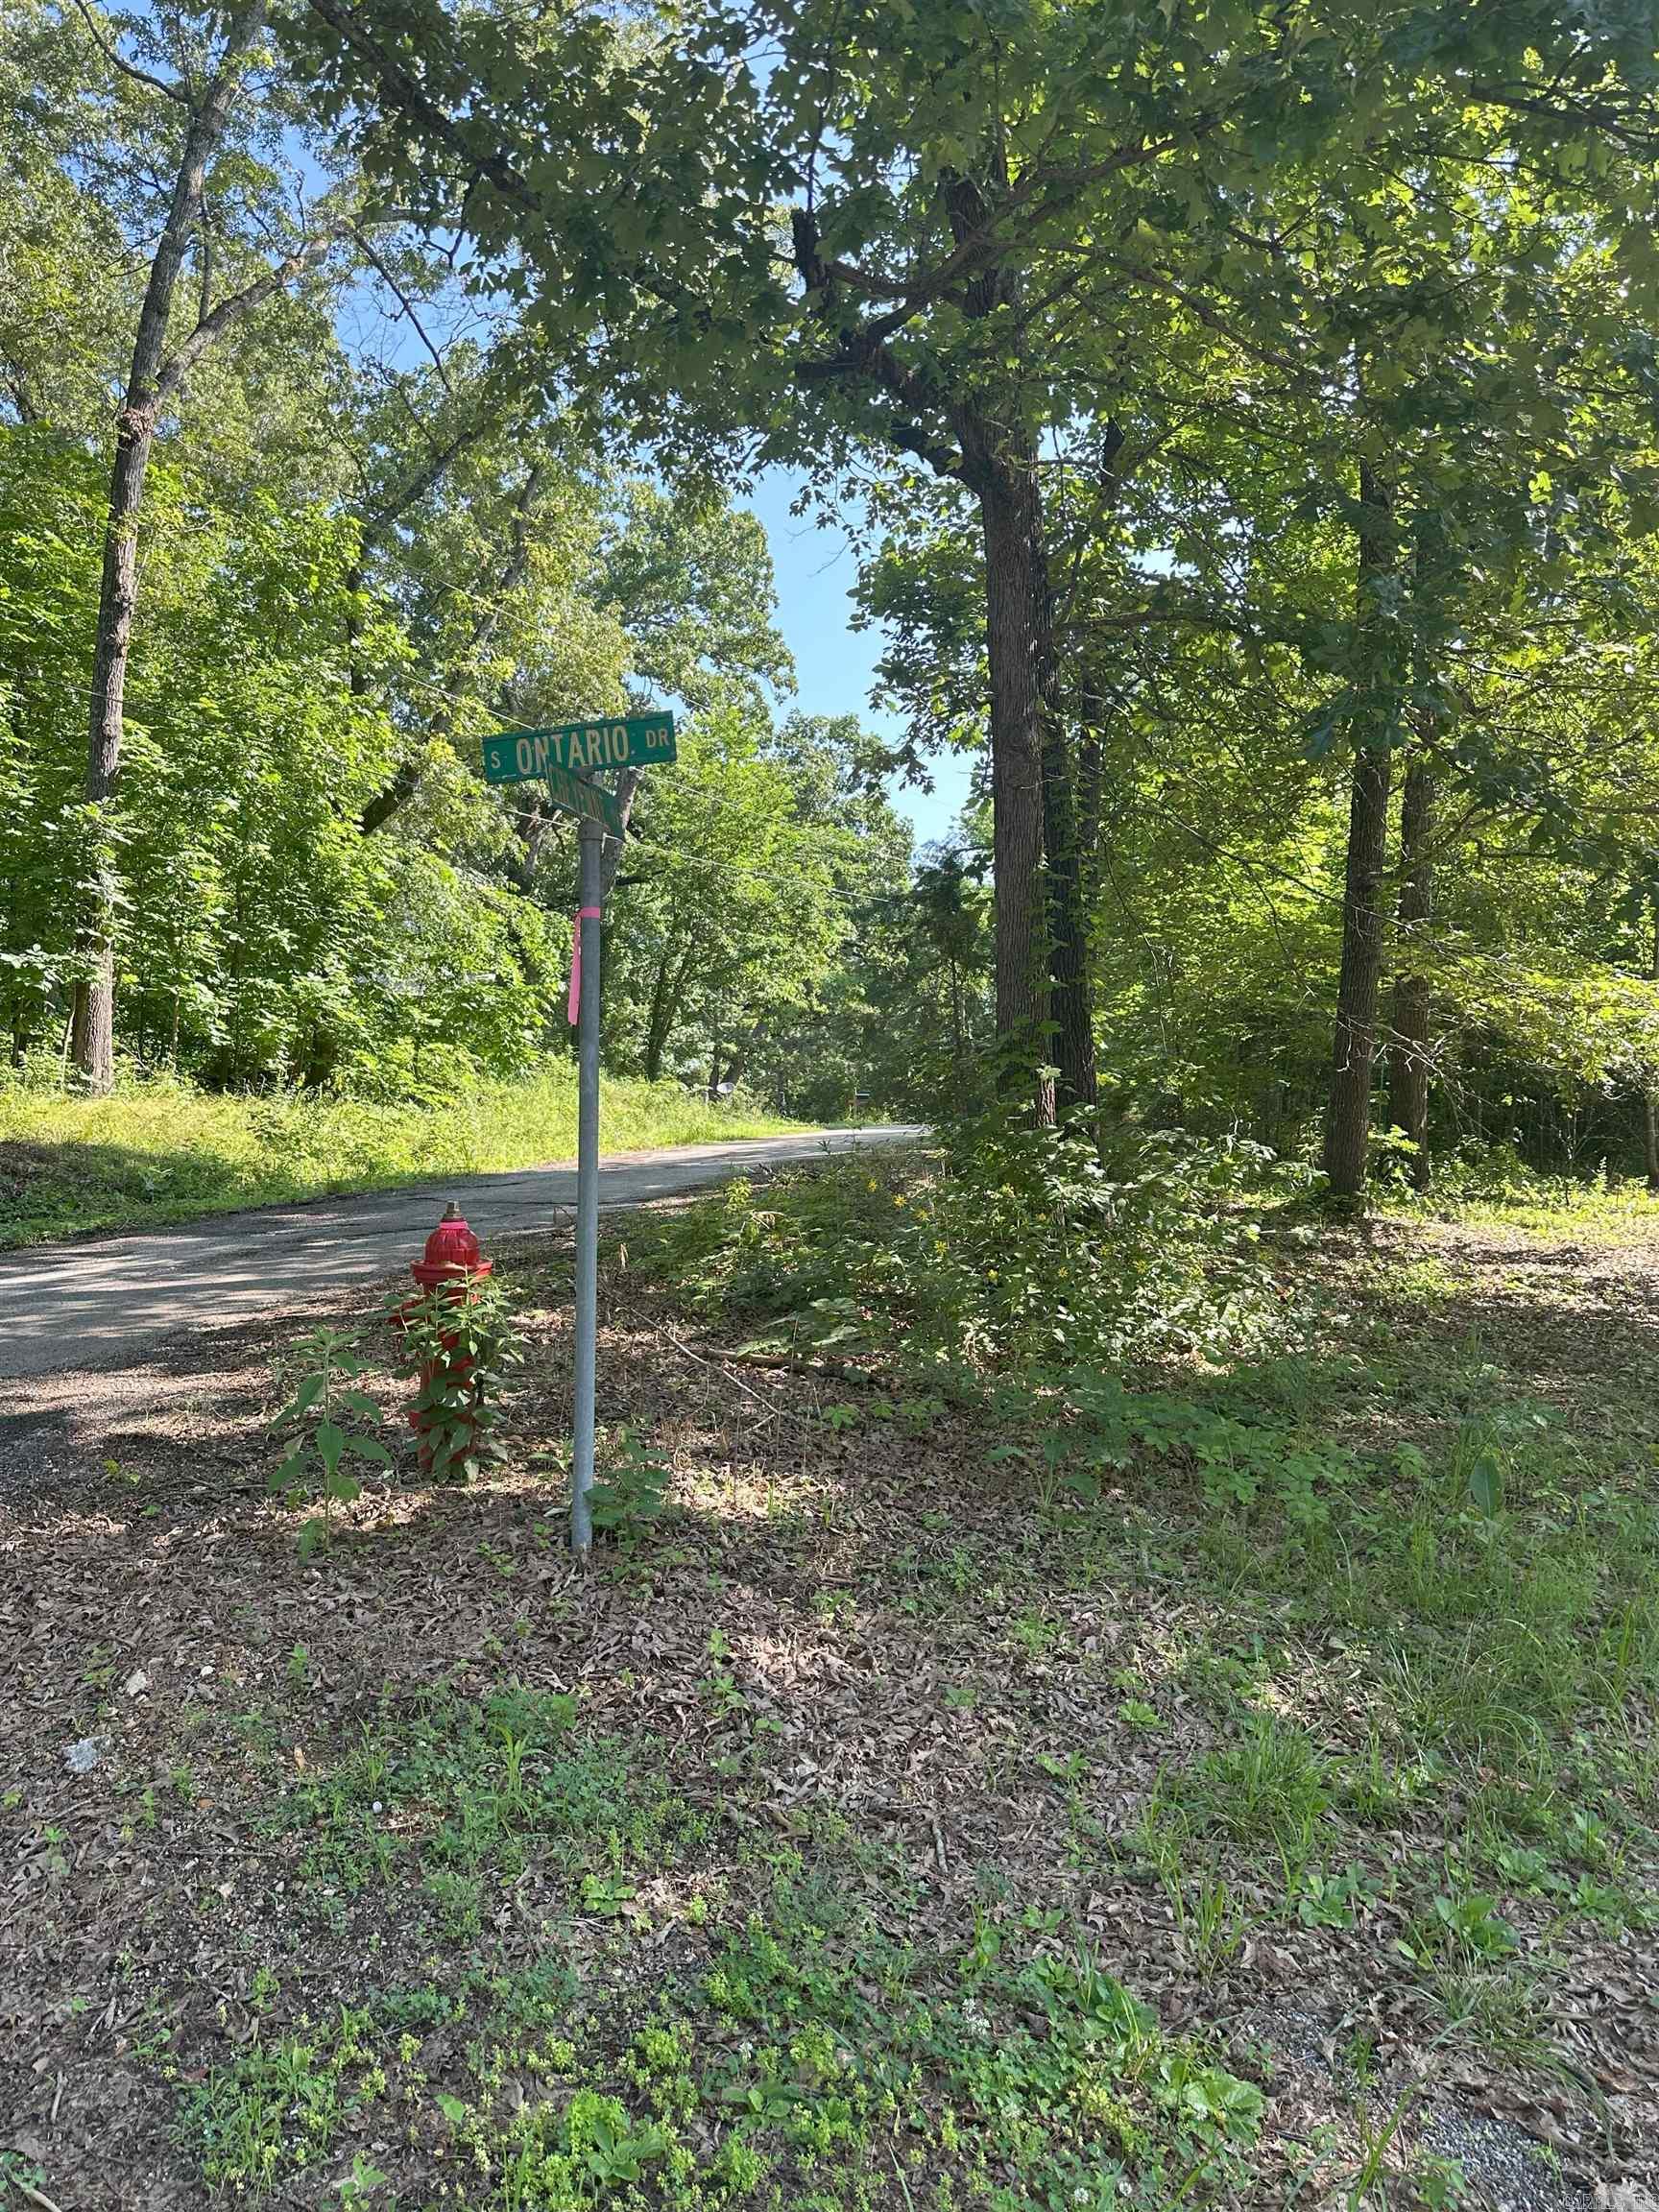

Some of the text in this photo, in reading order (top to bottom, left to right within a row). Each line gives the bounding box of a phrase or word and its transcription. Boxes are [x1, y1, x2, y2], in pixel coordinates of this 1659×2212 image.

[490, 725, 670, 775] S ONTARIO DR
